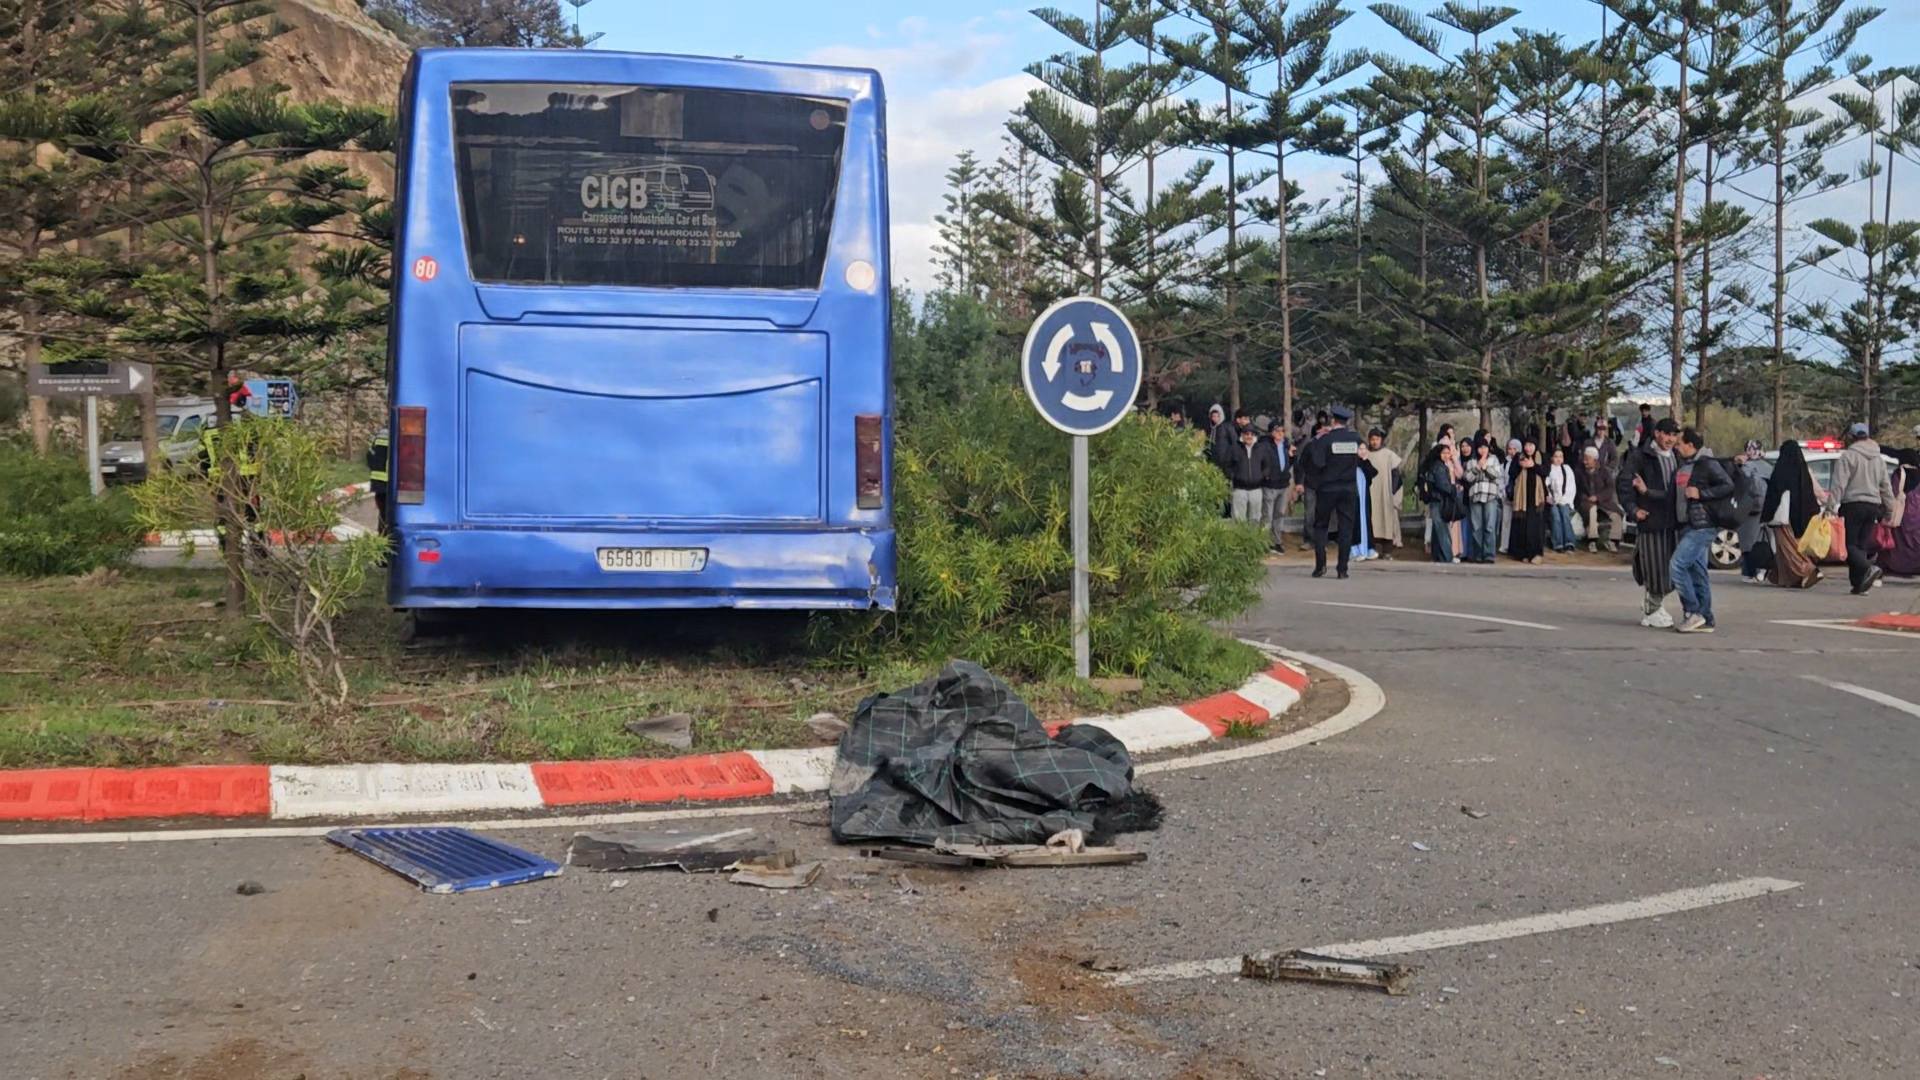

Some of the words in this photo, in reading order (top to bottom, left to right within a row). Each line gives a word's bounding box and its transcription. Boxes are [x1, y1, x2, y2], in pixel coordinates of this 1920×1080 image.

[581, 175, 648, 209] CICB
[630, 212, 674, 225] Industrielle
[676, 213, 690, 225] Car
[692, 214, 700, 226] et
[702, 214, 717, 226] Bus
[557, 226, 589, 234] ROUTE
[609, 228, 624, 236] KM
[656, 229, 709, 238] HARROUDA
[716, 230, 742, 239] CASA
[415, 259, 437, 279] 80
[607, 550, 652, 567] 65830
[690, 551, 698, 568] 7
